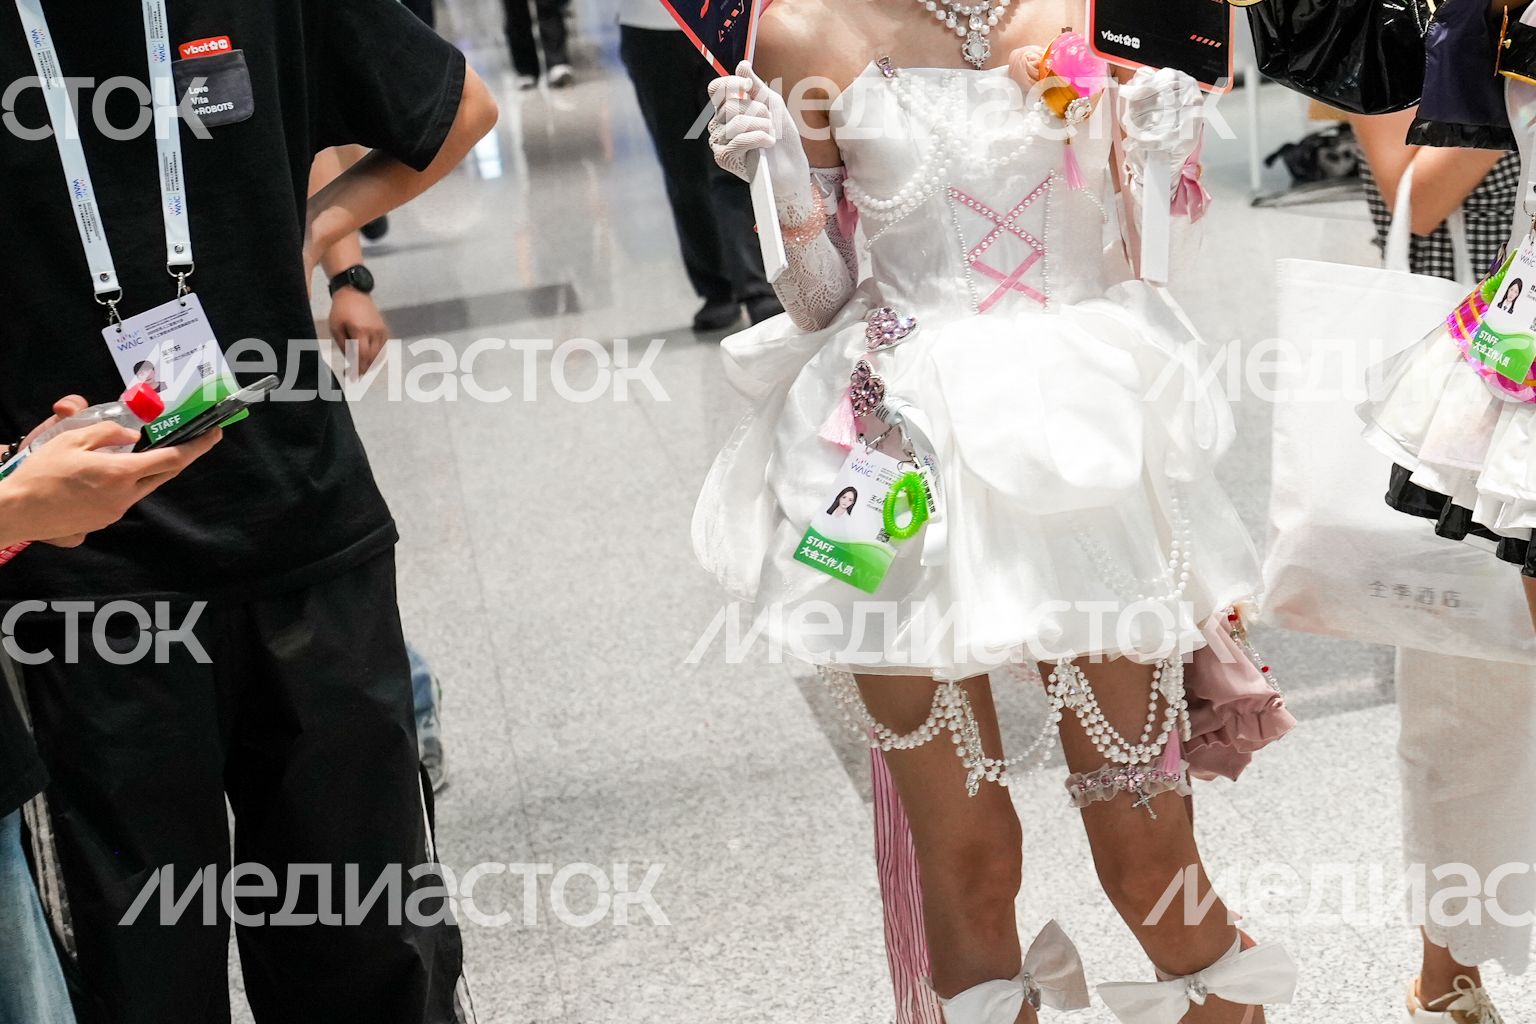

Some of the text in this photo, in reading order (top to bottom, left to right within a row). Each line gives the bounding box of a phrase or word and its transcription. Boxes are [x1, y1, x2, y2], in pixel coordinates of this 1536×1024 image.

[1101, 30, 1123, 45] vbot
[157, 43, 166, 62] WAIC
[183, 43, 209, 55] vbot
[188, 85, 208, 94] Love
[190, 95, 208, 105] Vita
[71, 178, 83, 199] WAIC
[172, 195, 183, 215] WAIC
[1518, 254, 1536, 268] WAIC
[116, 336, 144, 352] WAIC
[1477, 330, 1499, 346] STAFF
[1472, 340, 1511, 366] 大会工作人员
[149, 414, 182, 433] STAFF
[849, 462, 872, 477] WAIC
[805, 534, 834, 554] STAFF
[800, 544, 854, 576] 大会工作人员
